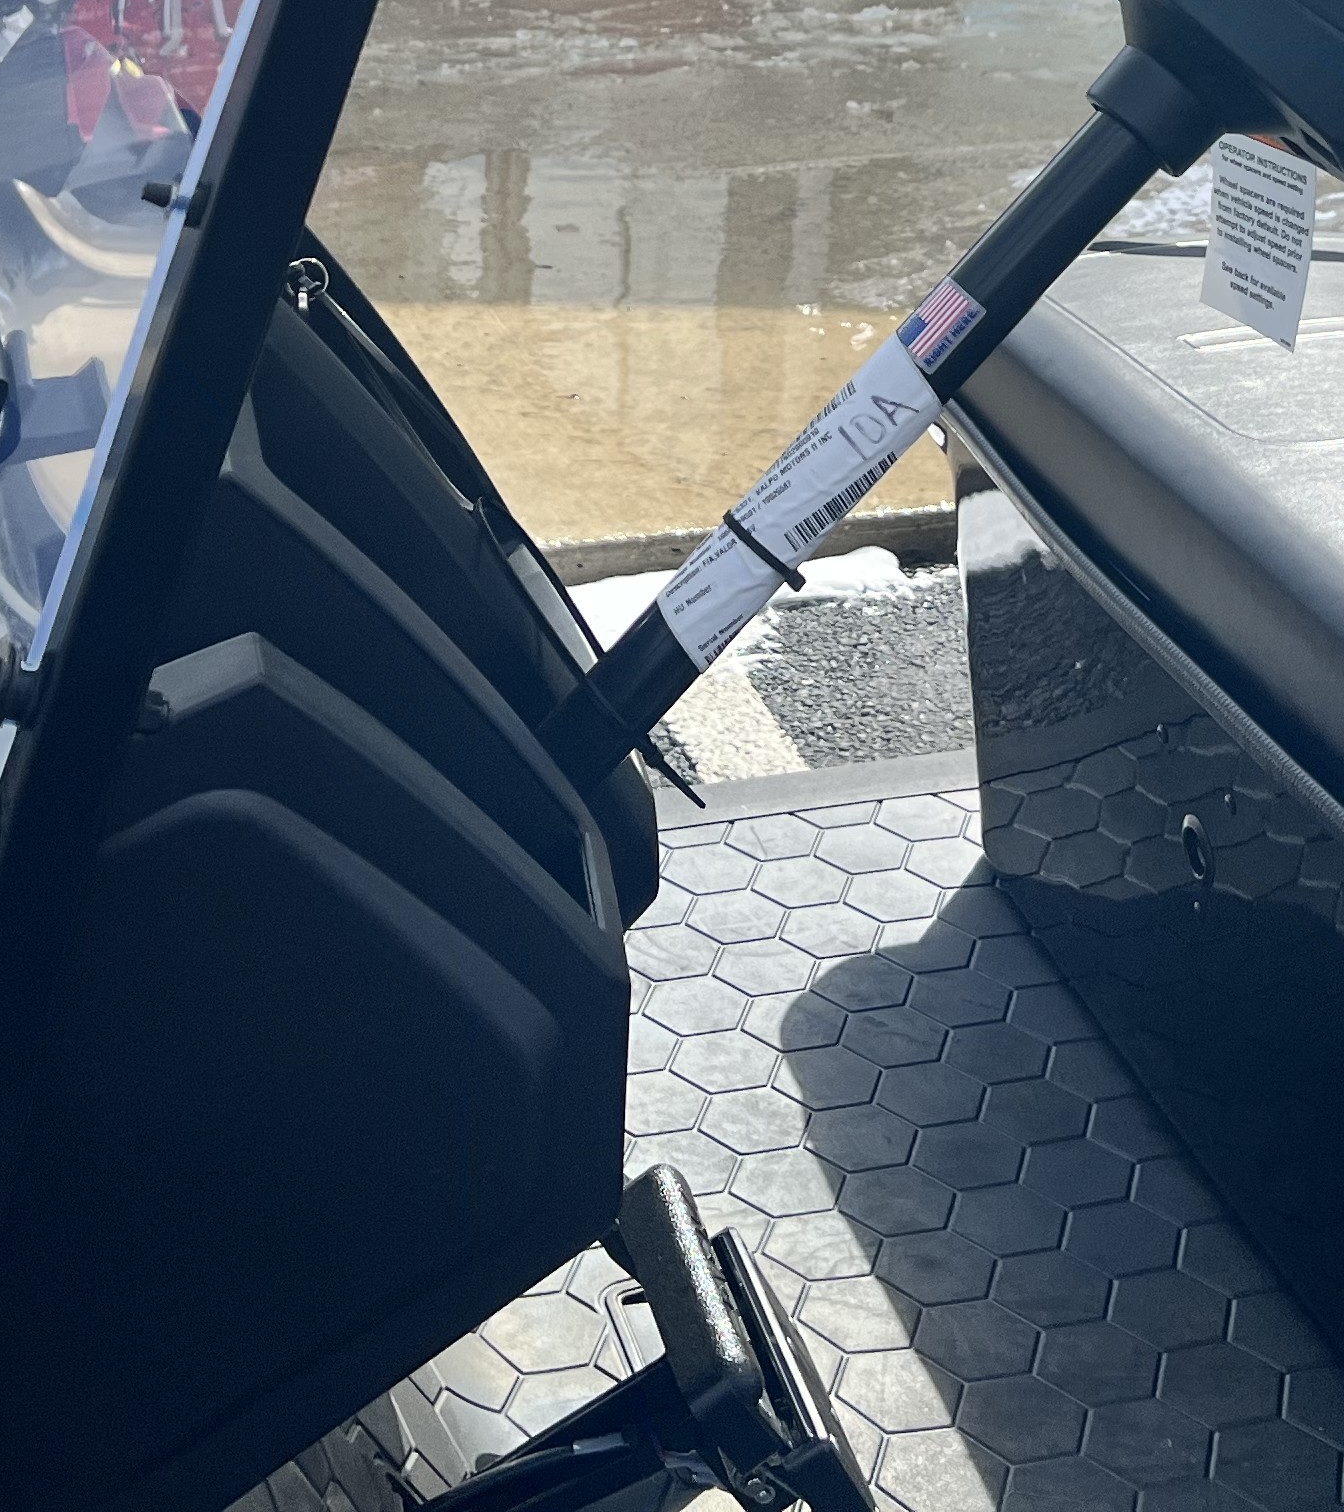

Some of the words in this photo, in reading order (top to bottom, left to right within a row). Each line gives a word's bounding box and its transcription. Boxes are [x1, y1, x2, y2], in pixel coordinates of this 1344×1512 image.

[1218, 141, 1256, 163] OPERATOR
[1257, 156, 1307, 185] INSTRUCTIONS
[1219, 175, 1238, 190] Wheel
[1240, 186, 1265, 202] spacers
[1266, 197, 1276, 207] are
[1277, 203, 1305, 221] required
[1218, 201, 1232, 215] from
[1233, 207, 1255, 227] factory
[1280, 229, 1291, 241] Do
[1291, 236, 1303, 248] not
[1231, 195, 1253, 211] vehicle
[1254, 206, 1274, 220] speed
[1281, 218, 1309, 236] changed
[1224, 232, 1252, 253] installing
[1253, 246, 1271, 260] wheel
[1247, 230, 1267, 245] adjust
[1268, 239, 1287, 254] speed
[1287, 249, 1303, 262] prior
[1230, 281, 1249, 296] speed
[1234, 268, 1249, 282] back
[1250, 275, 1259, 287] for
[1260, 283, 1286, 302] available
[923, 336, 953, 367] RIGHT
[697, 633, 718, 652] Serial
